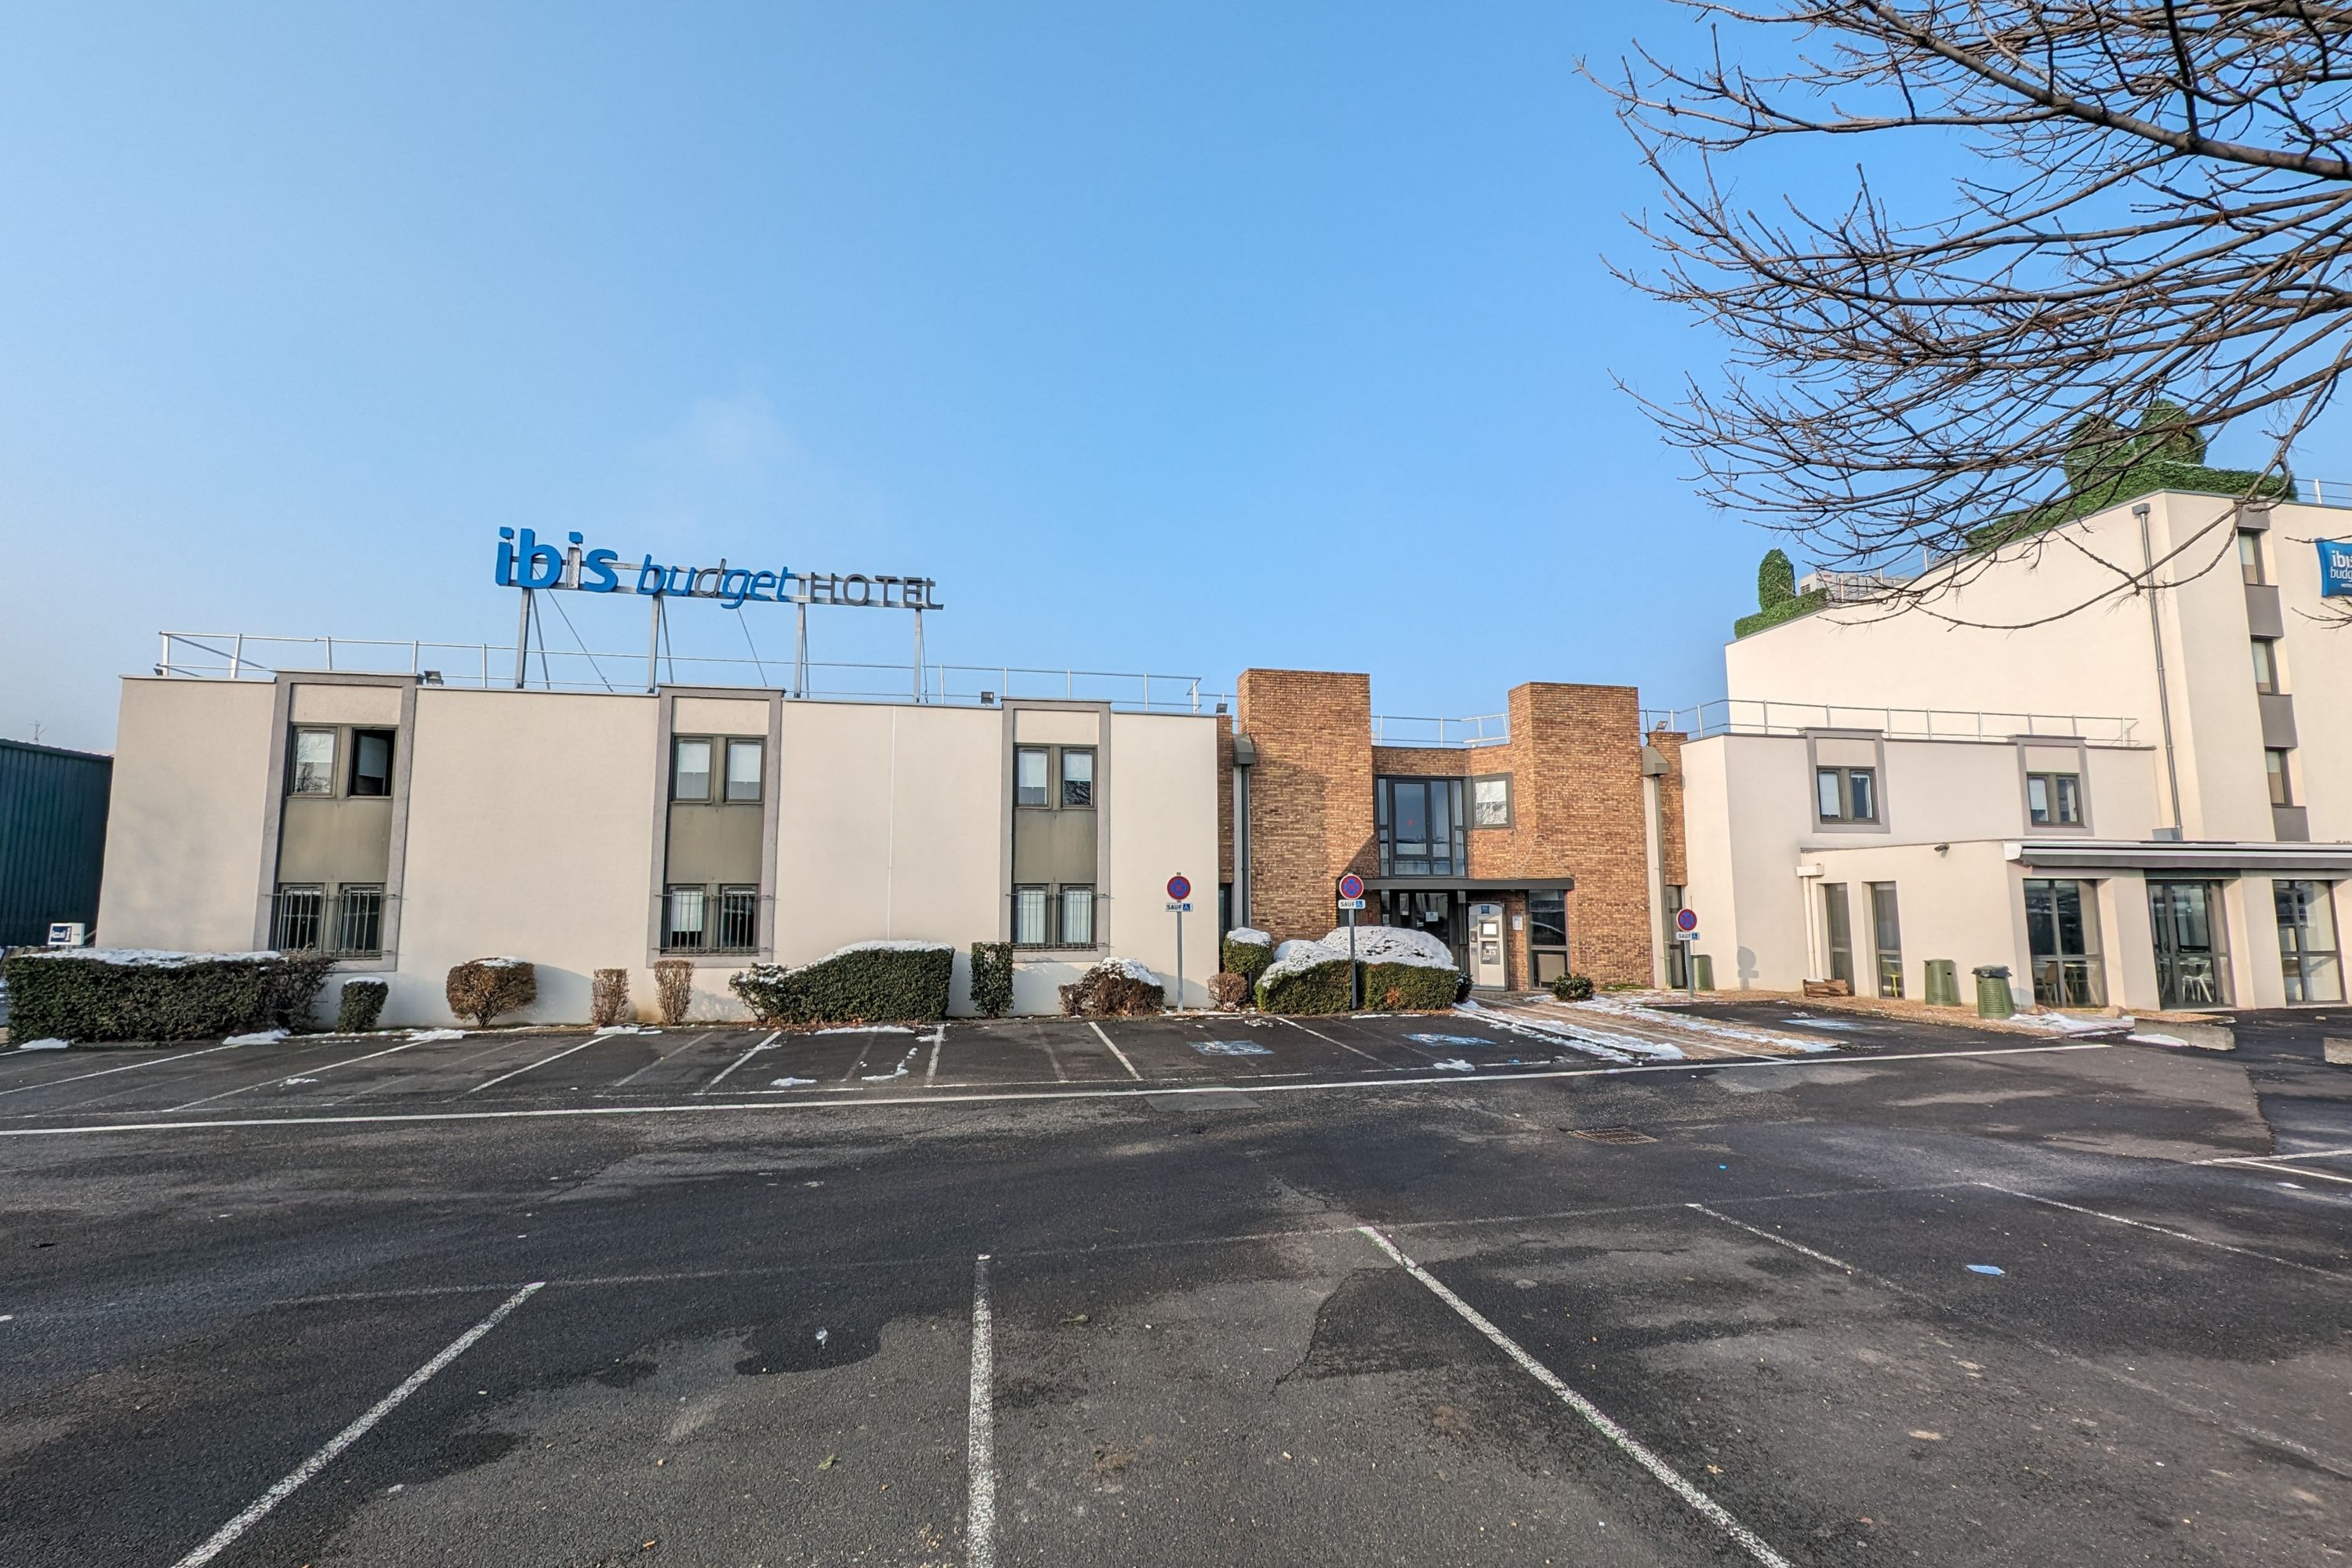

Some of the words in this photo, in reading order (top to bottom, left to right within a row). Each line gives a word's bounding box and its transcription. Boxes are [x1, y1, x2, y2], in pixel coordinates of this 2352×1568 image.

[495, 527, 618, 593] ibis
[637, 554, 794, 609] budget
[809, 572, 944, 610] HOTEL
